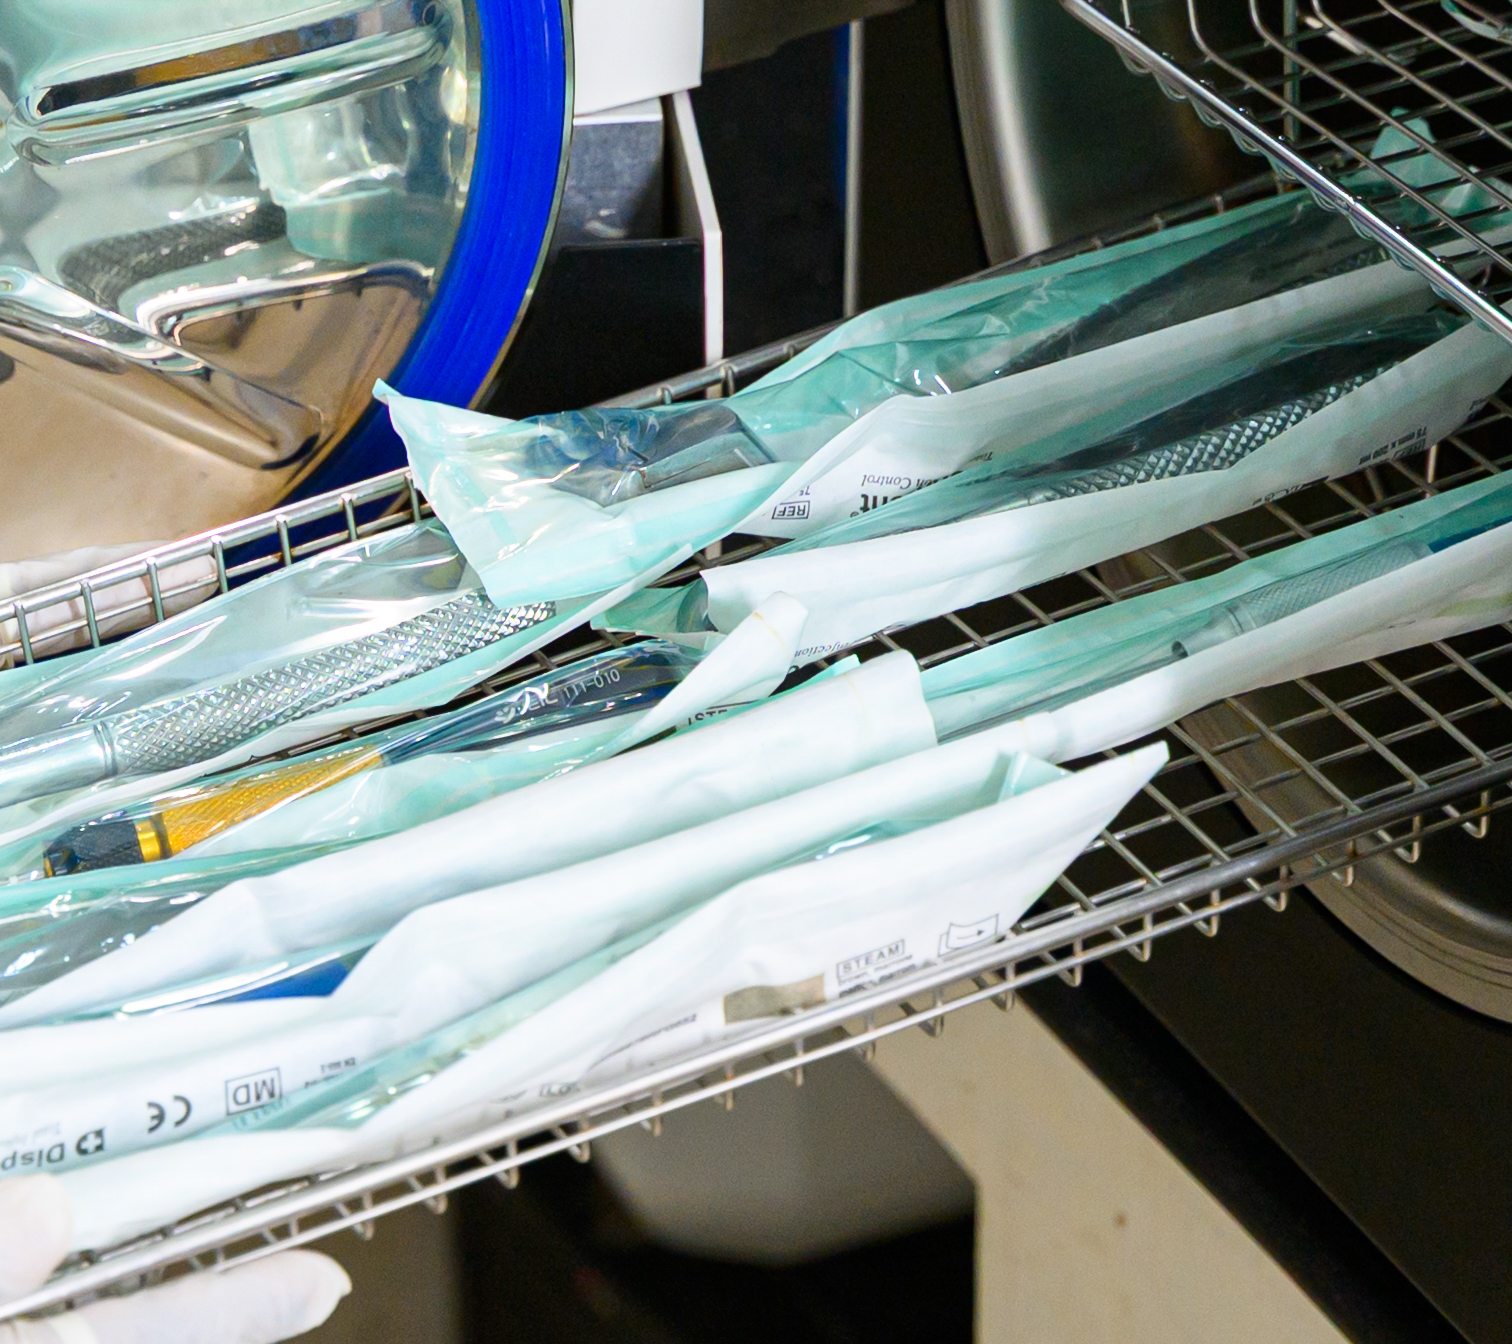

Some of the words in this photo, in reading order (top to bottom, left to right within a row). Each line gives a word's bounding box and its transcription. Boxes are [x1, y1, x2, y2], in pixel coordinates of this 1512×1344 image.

[861, 474, 912, 490] Control
[777, 504, 807, 517] REF
[843, 943, 900, 974] STEAM
[232, 1076, 276, 1106] MD
